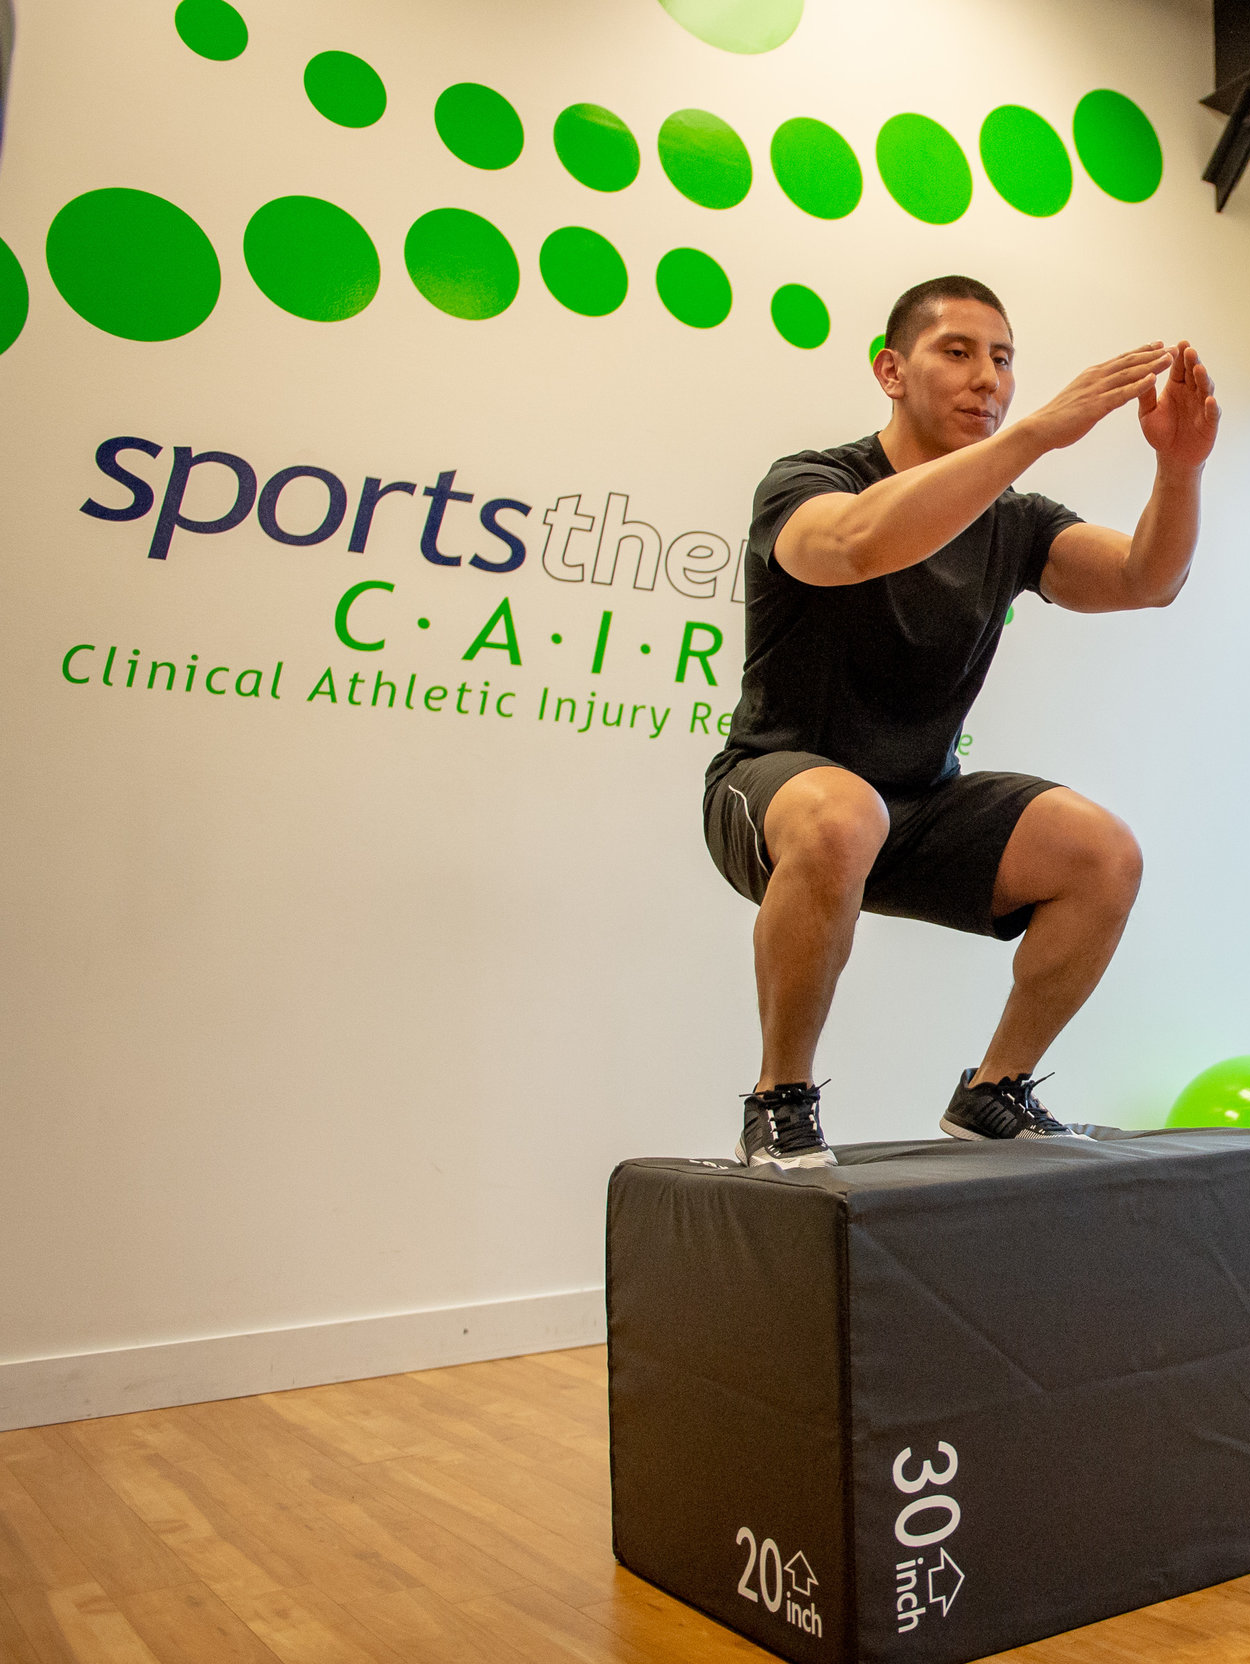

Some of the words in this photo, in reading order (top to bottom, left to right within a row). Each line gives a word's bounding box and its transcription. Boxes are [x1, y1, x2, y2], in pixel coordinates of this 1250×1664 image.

[61, 644, 283, 700] Clinical
[306, 666, 516, 719] Athletic
[538, 687, 671, 740] Injury
[892, 1440, 961, 1547] 30
[735, 1526, 783, 1613] 20
[786, 1591, 823, 1638] inch
[895, 1556, 926, 1633] inch
